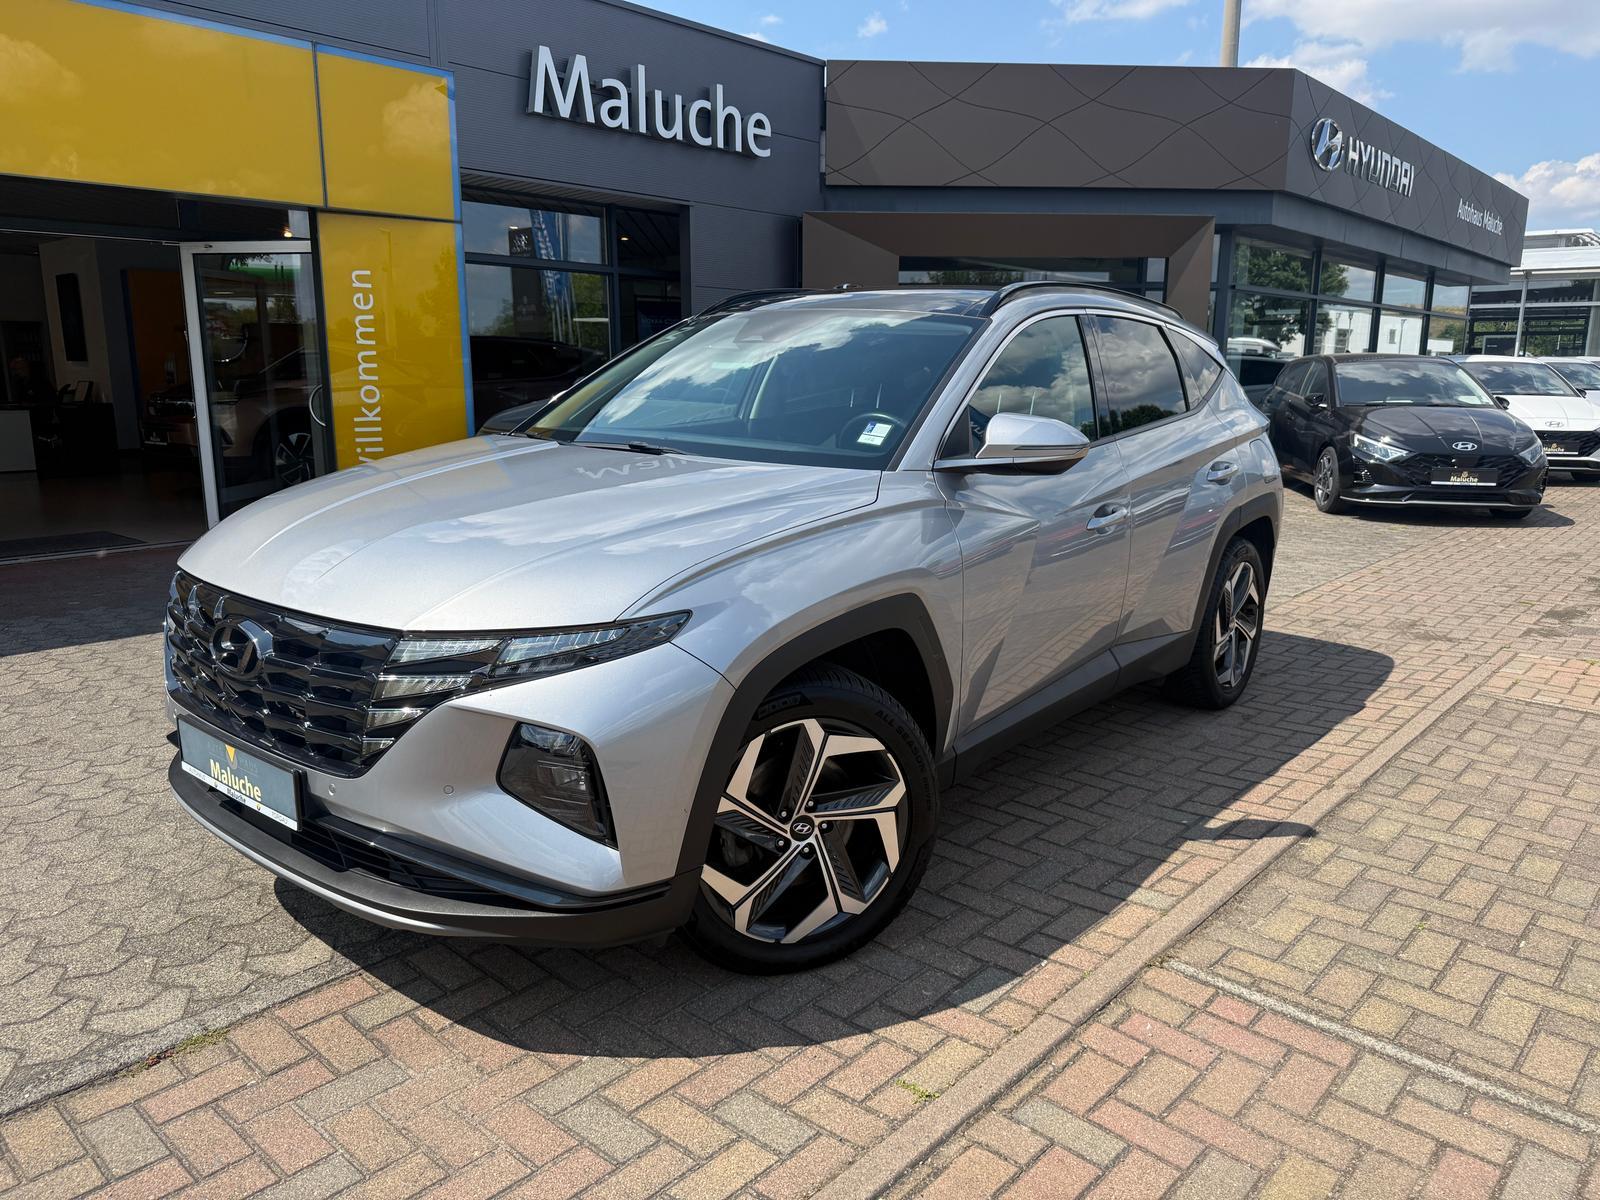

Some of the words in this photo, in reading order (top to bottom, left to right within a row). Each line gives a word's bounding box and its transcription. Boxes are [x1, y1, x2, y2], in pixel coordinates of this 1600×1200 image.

[530, 45, 772, 157] Maluche
[1346, 136, 1415, 198] HYUNDAI
[1456, 198, 1484, 227] Autohaus
[1483, 209, 1503, 236] Maluche
[1450, 475, 1479, 483] Maluche
[209, 758, 262, 802] Maluche
